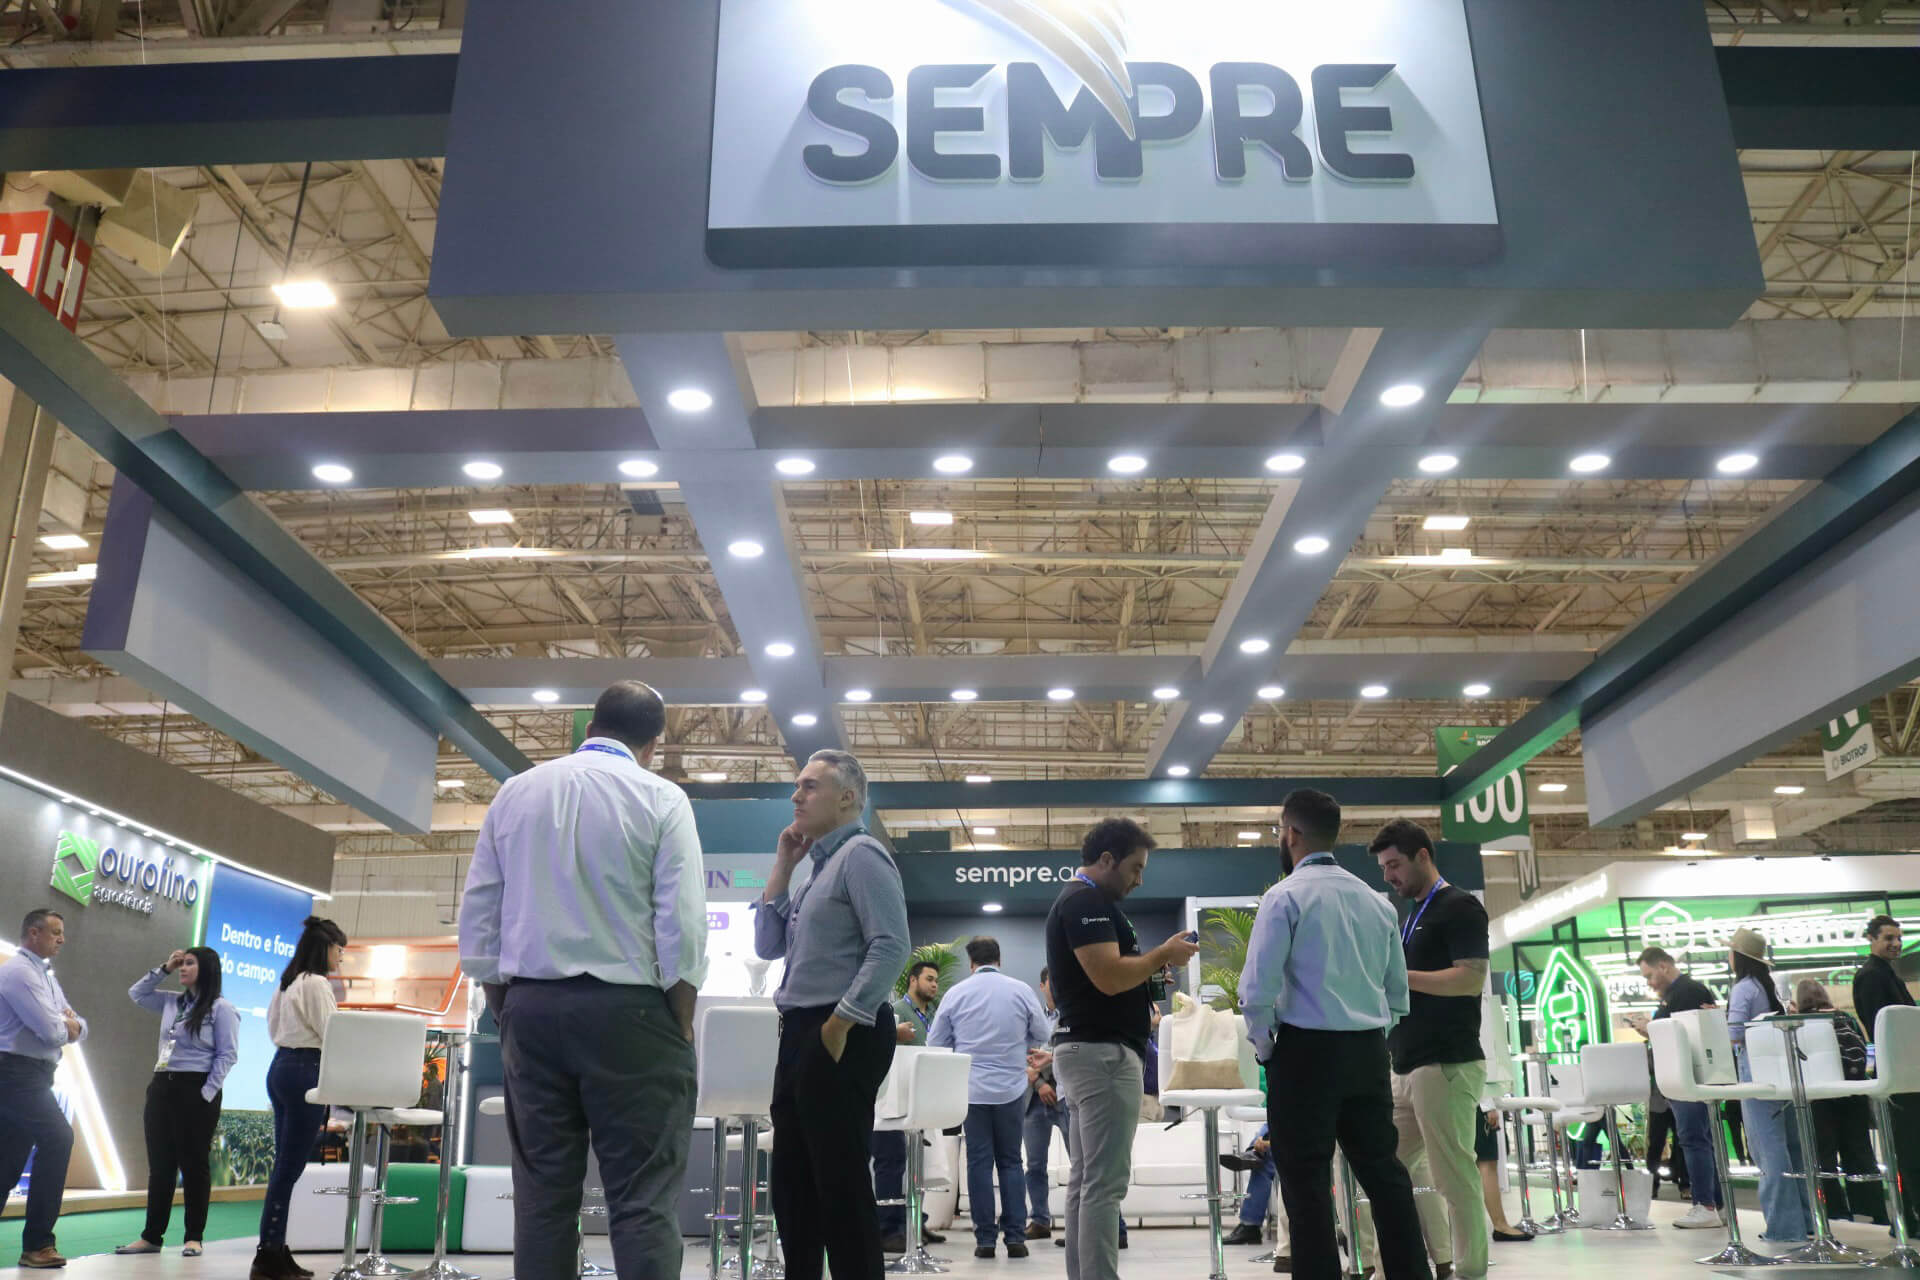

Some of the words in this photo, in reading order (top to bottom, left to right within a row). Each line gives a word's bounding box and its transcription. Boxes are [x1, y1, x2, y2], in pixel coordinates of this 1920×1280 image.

[802, 61, 1415, 184] SEMPRE
[43, 239, 84, 318] H
[99, 847, 199, 906] ourofino
[955, 865, 1083, 888] sempre.a
[221, 922, 262, 950] Dentro
[263, 937, 273, 953] e
[273, 934, 296, 959] fora
[236, 960, 276, 985] campo
